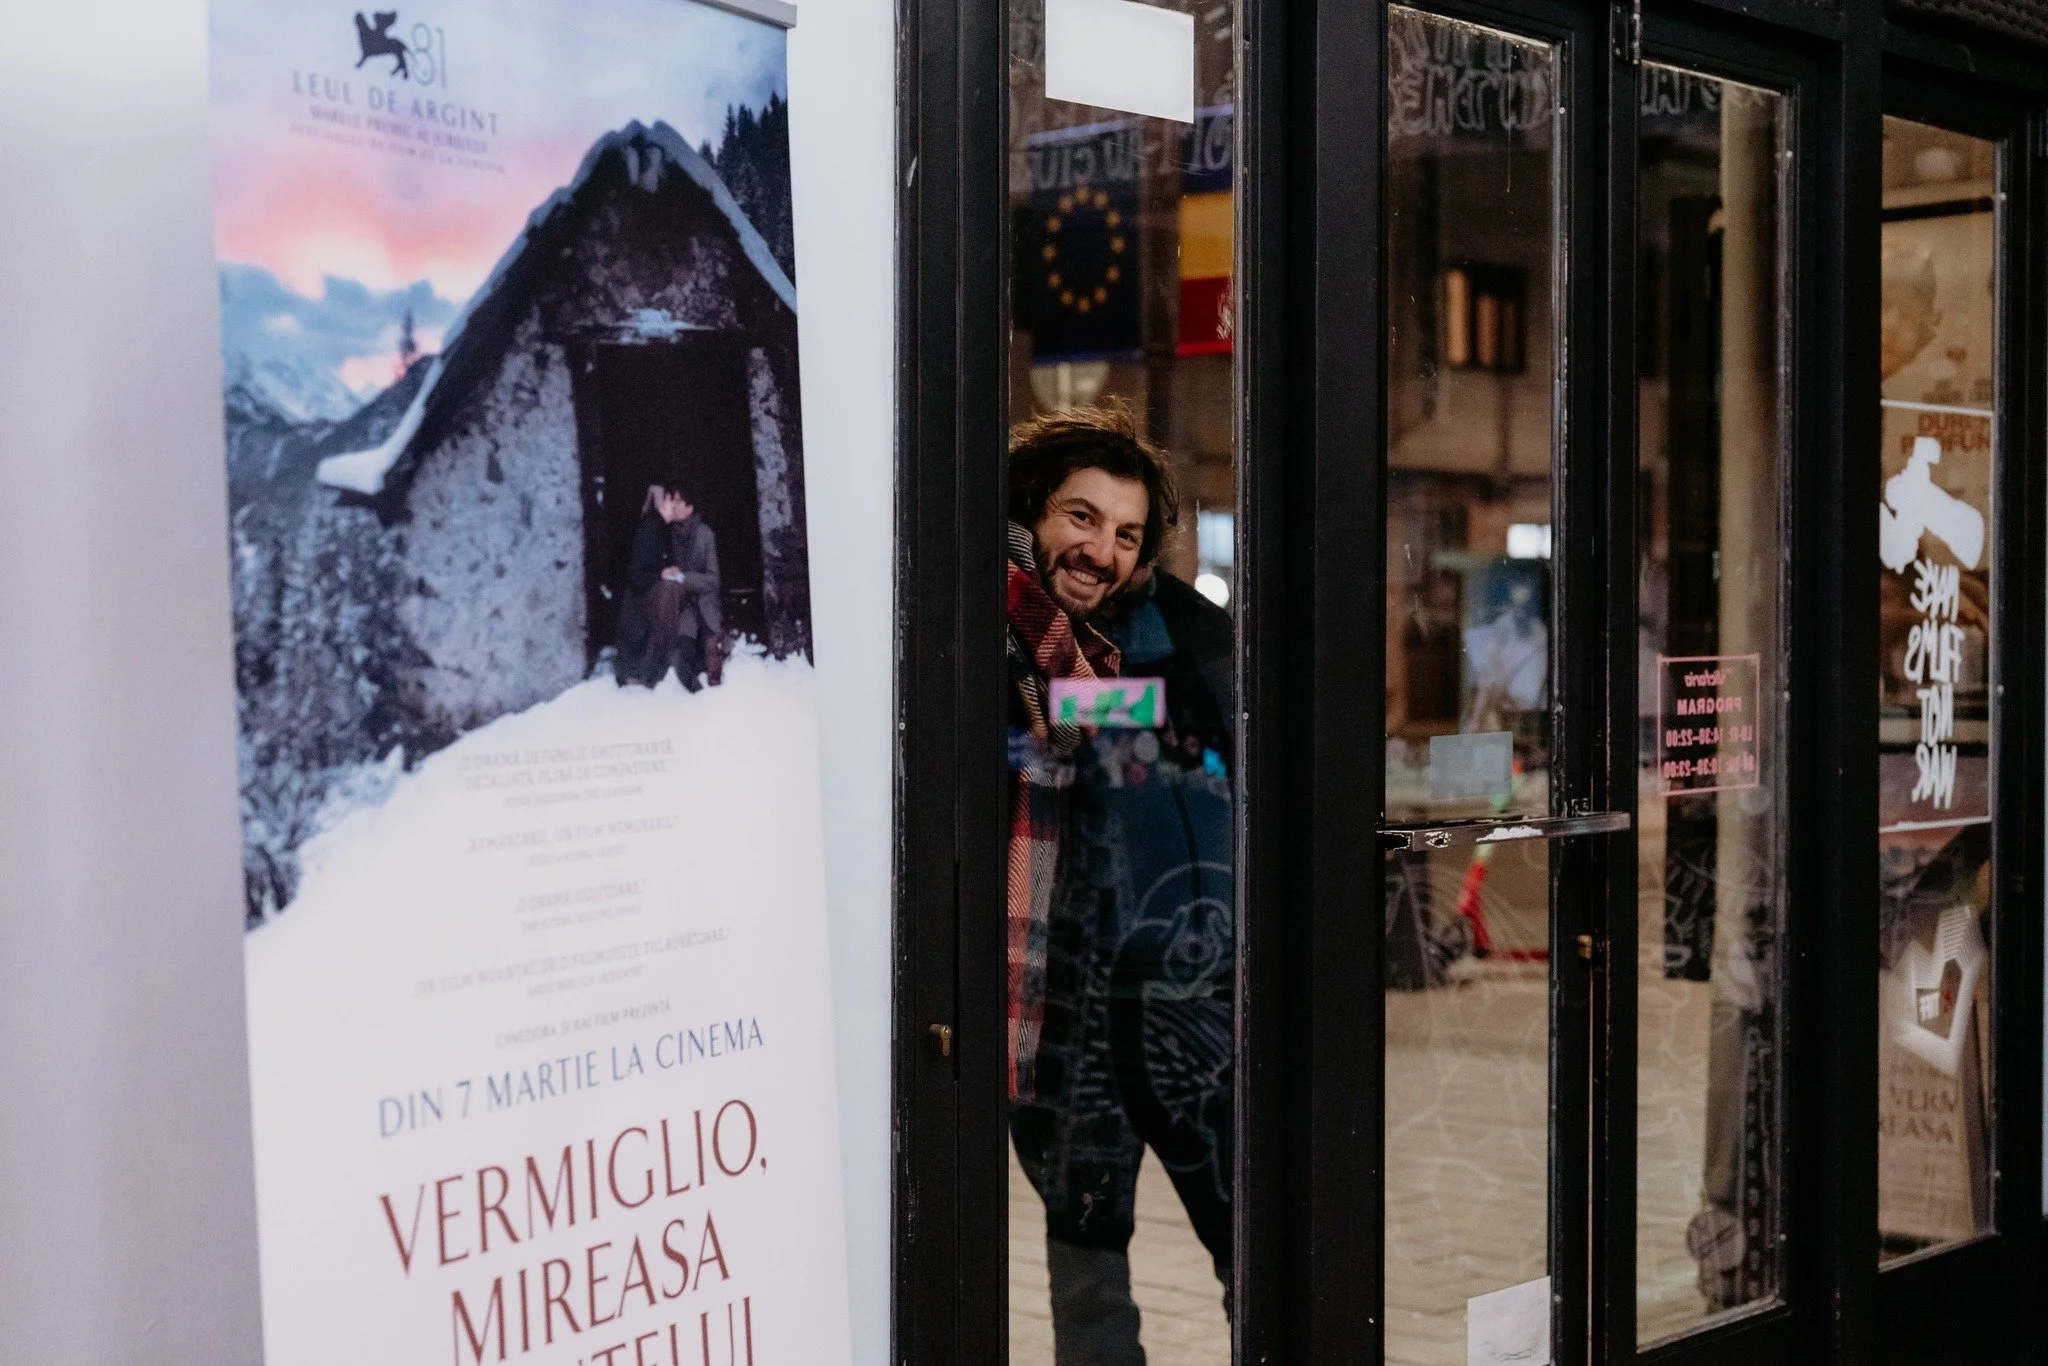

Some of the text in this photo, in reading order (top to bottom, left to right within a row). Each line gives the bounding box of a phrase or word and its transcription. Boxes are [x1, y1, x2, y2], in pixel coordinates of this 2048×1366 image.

[292, 69, 499, 136] LEUL DE ARGINT
[411, 22, 448, 90] 81
[378, 1017, 764, 1138] DIN 7 MARTIE LA CINEMA
[379, 1099, 767, 1277] VERMIGLIO,
[451, 1209, 730, 1366] MIREASA
